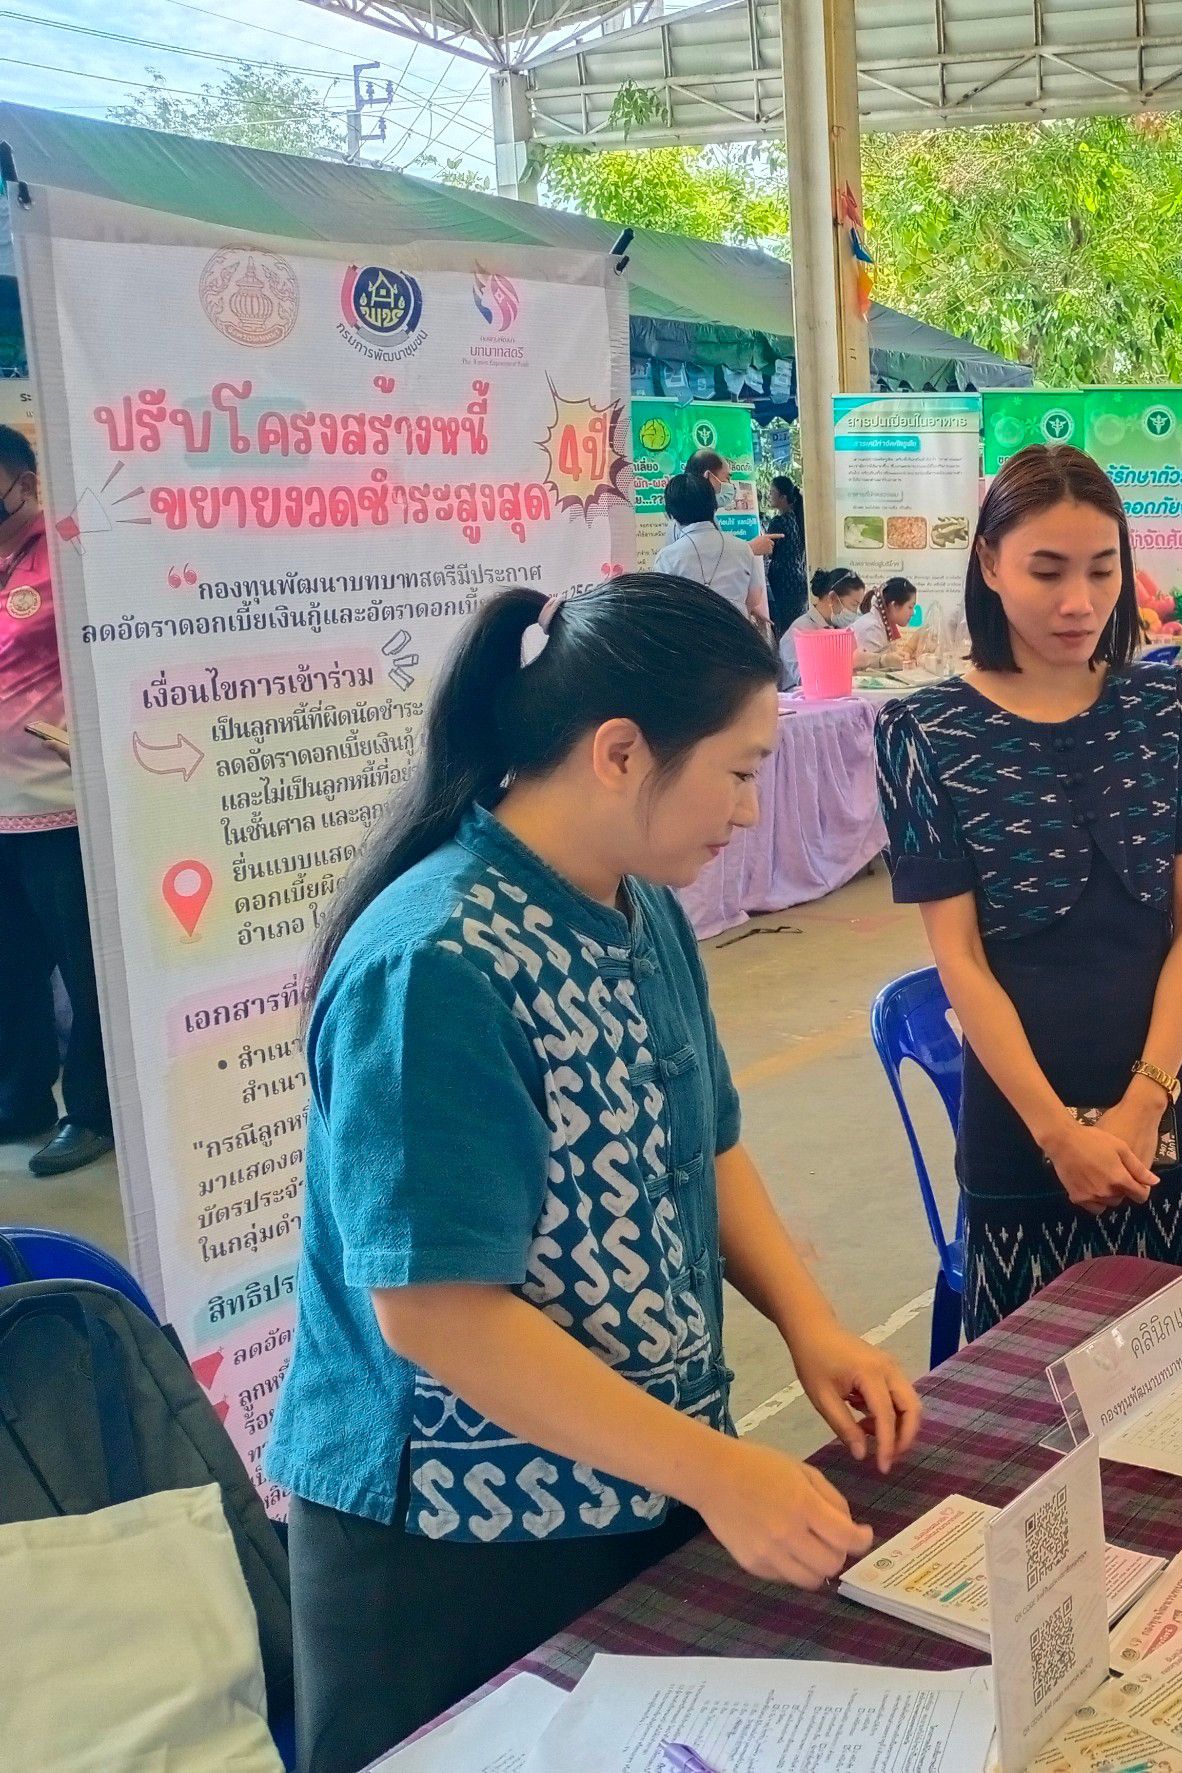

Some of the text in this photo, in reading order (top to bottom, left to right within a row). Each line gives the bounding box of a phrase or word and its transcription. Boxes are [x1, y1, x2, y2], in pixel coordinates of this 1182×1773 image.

[336, 322, 428, 361] กรมการพัฒนาชุมชน
[470, 346, 525, 358] บทบาทสตรี
[93, 375, 490, 457] ปรับโครงสร้างหนี้
[149, 468, 552, 545] ขยายงวดชำระสูงสุด
[199, 564, 542, 604] กองทุนพัฒนาบทบาทสตรีมีประกาศ
[82, 587, 486, 643] ลดอัตราดอกเบี้ยเงินกู้และอัตราดอกเบี้
[143, 660, 374, 709] เงื่อนไขการเข้าร่วม
[221, 802, 389, 846] ในชั้นศาล และลูก
[237, 915, 305, 946] อำเภอ
[242, 1071, 307, 1103] สำเนา
[199, 1148, 306, 1197] มาแสดงต
[233, 1327, 295, 1366] ลดอัต
